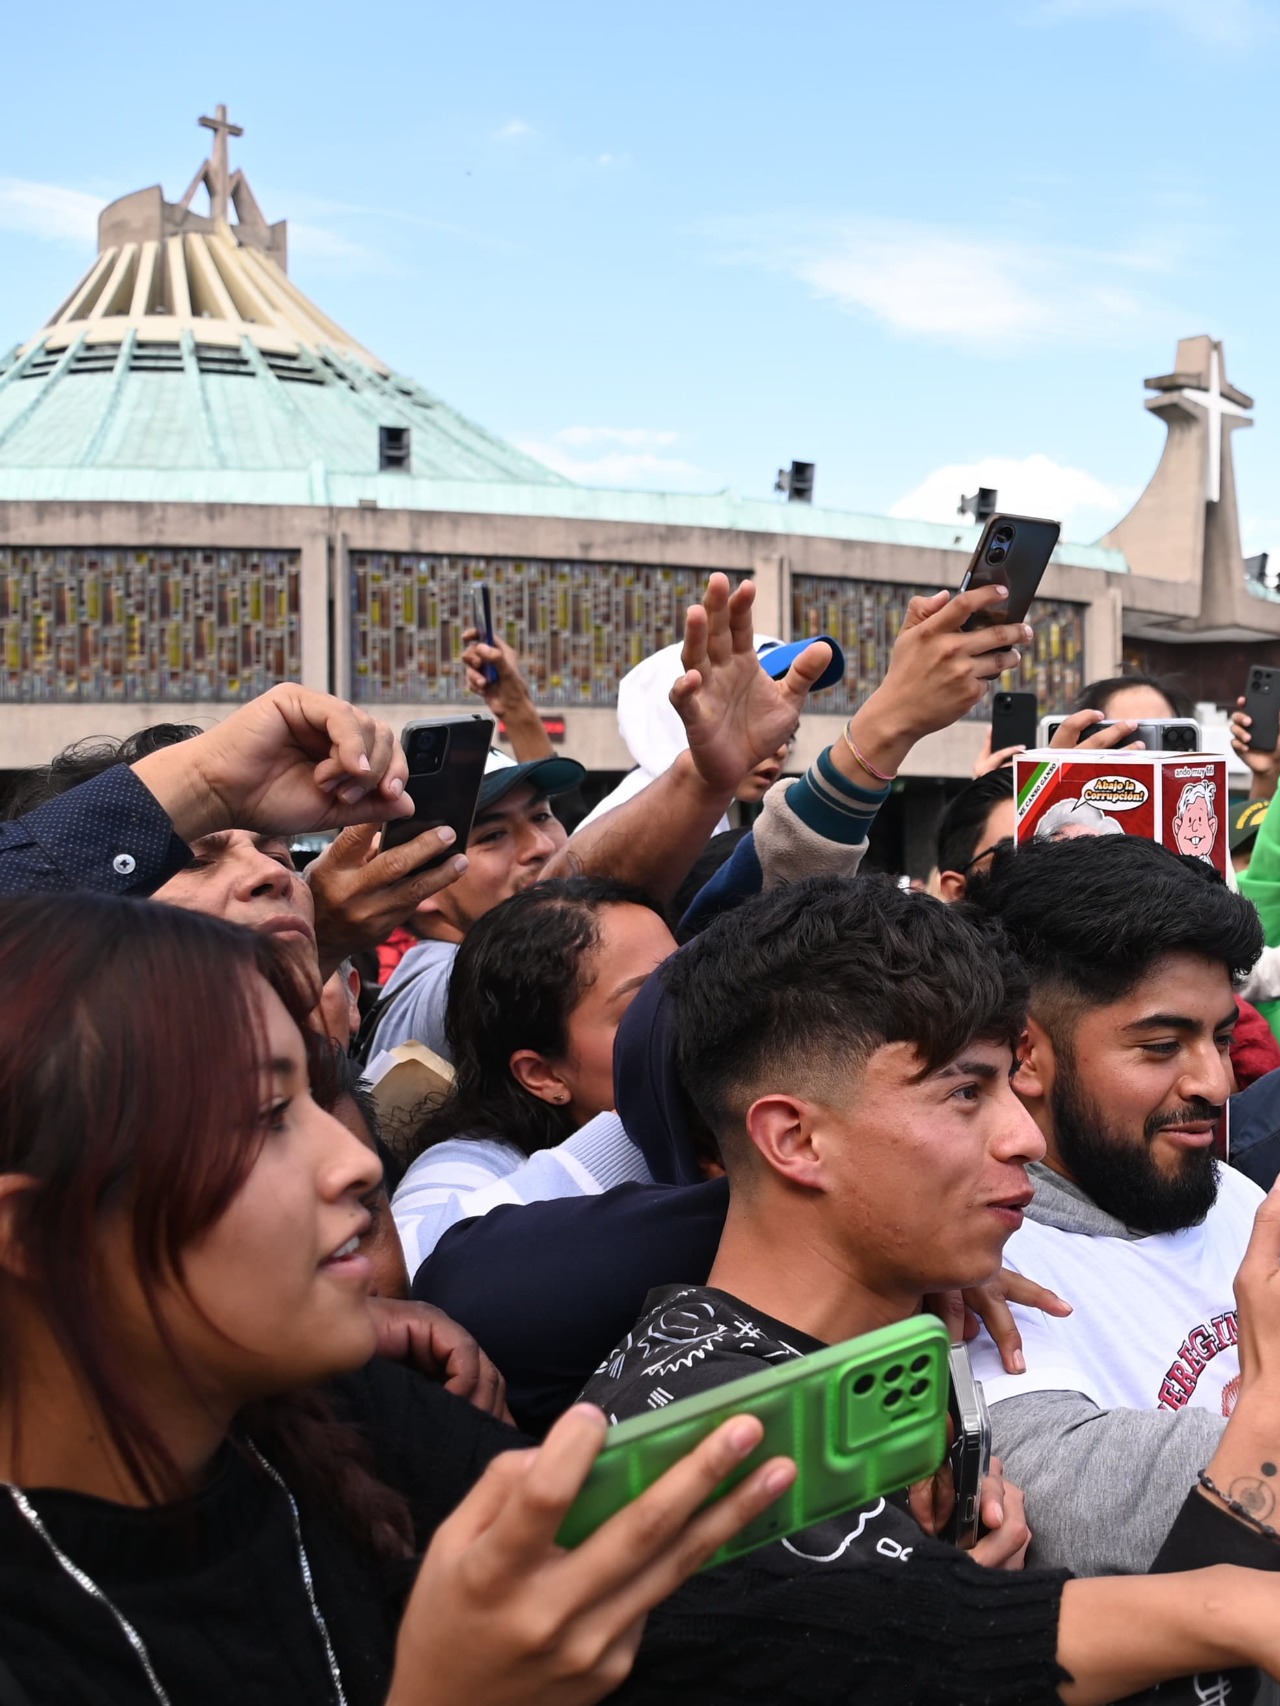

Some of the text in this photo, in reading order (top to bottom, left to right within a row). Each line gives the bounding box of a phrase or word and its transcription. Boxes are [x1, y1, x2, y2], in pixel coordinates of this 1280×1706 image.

[1175, 766, 1191, 777] ando
[1191, 768, 1206, 778] muy
[1094, 779, 1136, 792] Abajo la
[1025, 785, 1041, 807] CANSO
[1084, 789, 1145, 803] Corrupción!
